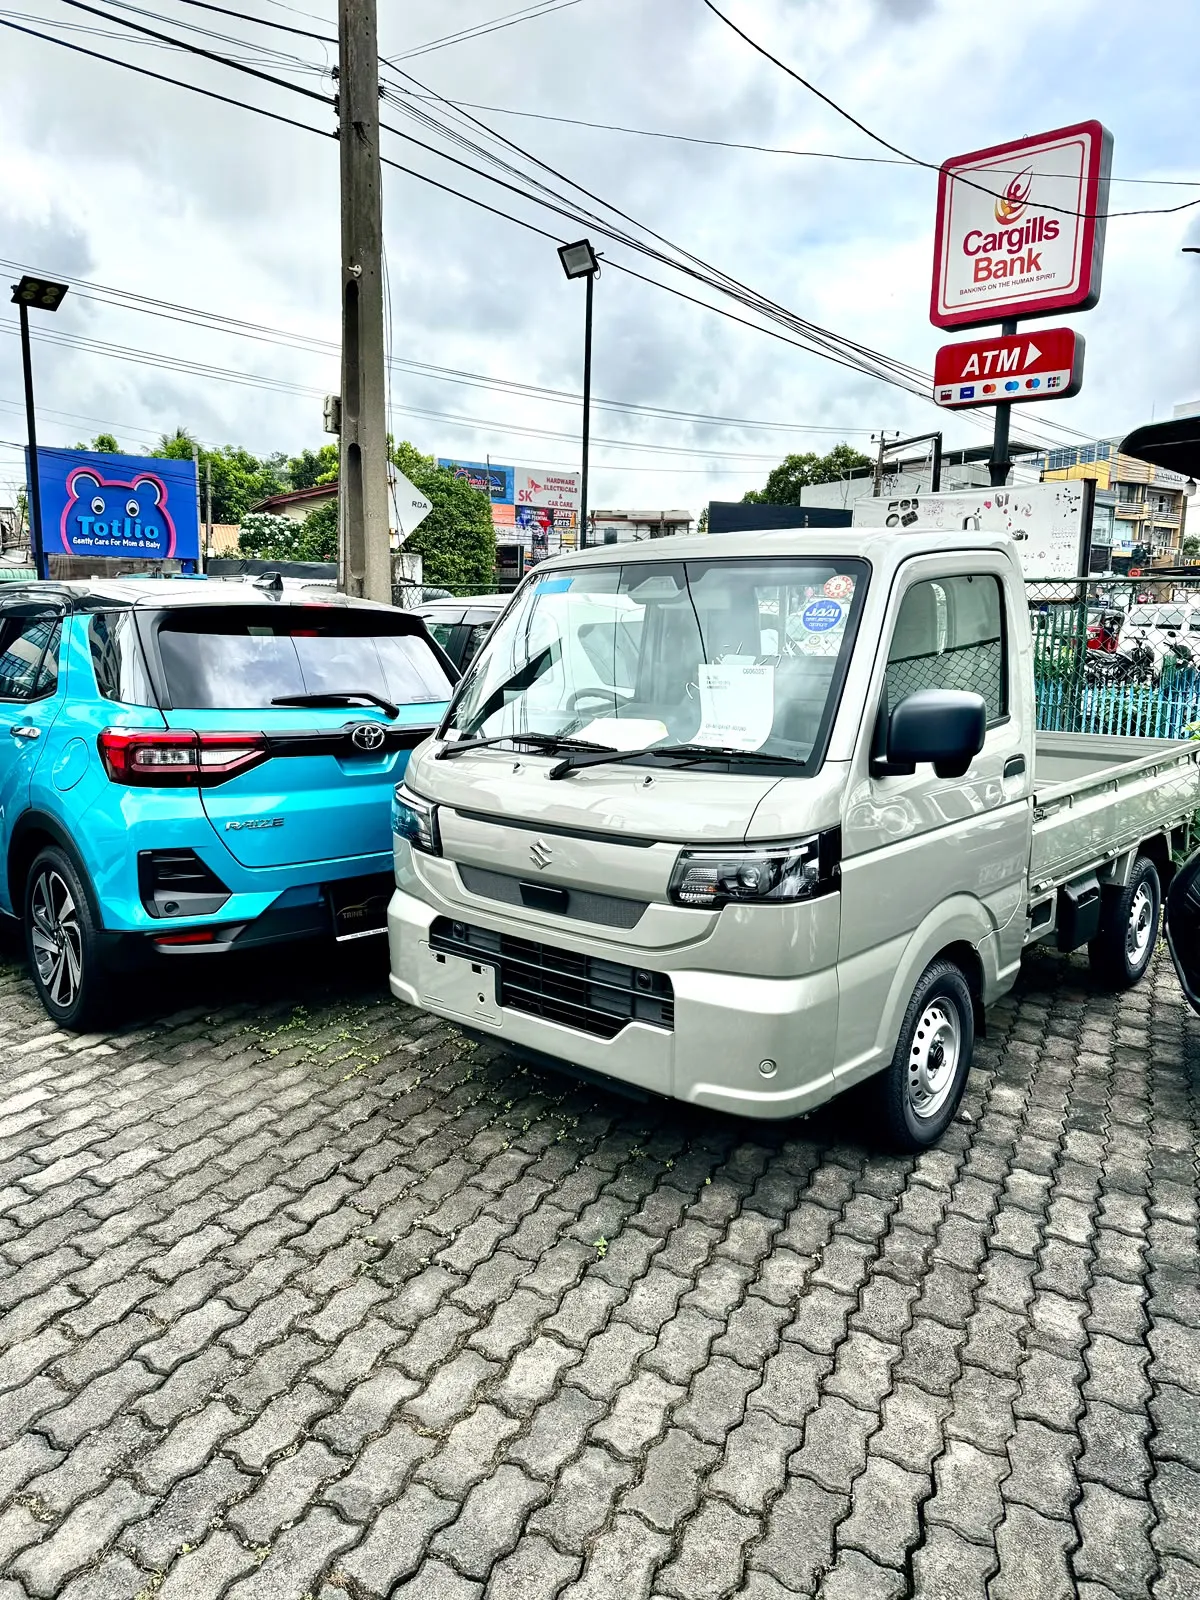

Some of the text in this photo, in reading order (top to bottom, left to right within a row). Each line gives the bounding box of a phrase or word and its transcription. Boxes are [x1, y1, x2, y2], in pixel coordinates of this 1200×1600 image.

[963, 216, 1060, 256] Cargills
[973, 248, 1043, 283] Bank
[959, 272, 1057, 296] BANKING ON THE HUMAN SPIRIT
[960, 346, 1021, 378] ATM
[543, 484, 578, 494] ELECTRICALS
[546, 477, 576, 486] HARDWARE
[518, 489, 533, 503] SK
[411, 500, 428, 510] RDA
[76, 515, 160, 539] Totlio
[122, 540, 138, 548] Mom
[145, 541, 161, 550] Baby
[225, 816, 285, 831] RAIZE
